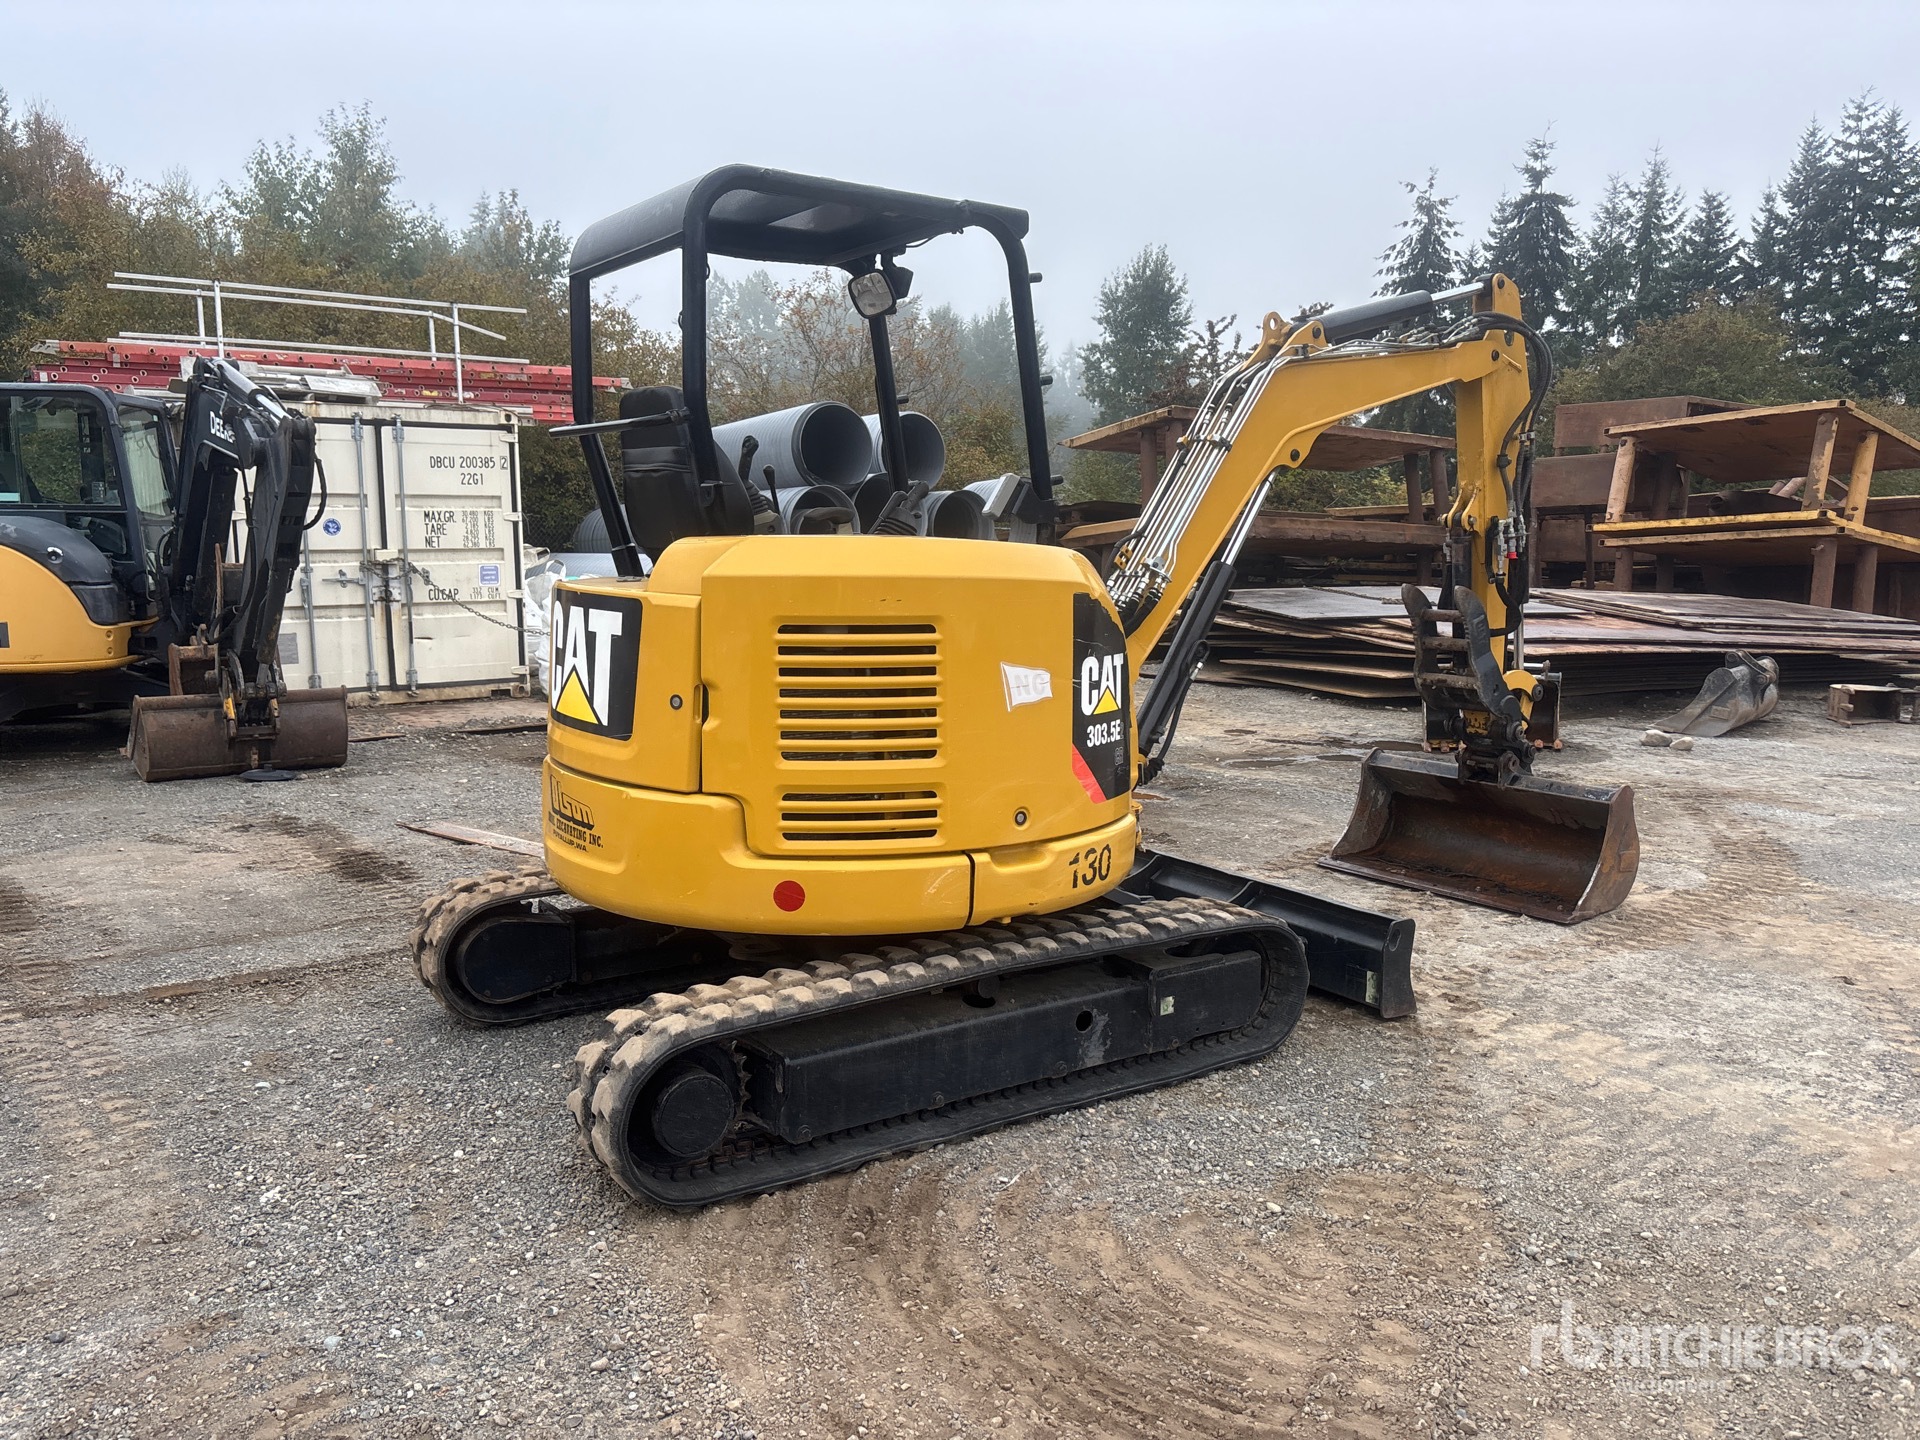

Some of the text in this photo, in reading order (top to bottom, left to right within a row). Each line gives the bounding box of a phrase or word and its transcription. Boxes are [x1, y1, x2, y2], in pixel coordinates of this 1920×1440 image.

[210, 410, 236, 443] DEE
[429, 456, 455, 469] DBCU
[459, 456, 496, 469] 200385
[460, 472, 484, 486] 22G1
[424, 523, 447, 535] TARE
[425, 535, 441, 548] NET
[552, 600, 623, 727] CAT
[1080, 653, 1124, 716] CAT
[588, 832, 604, 848] INC.
[1069, 844, 1112, 889] 130
